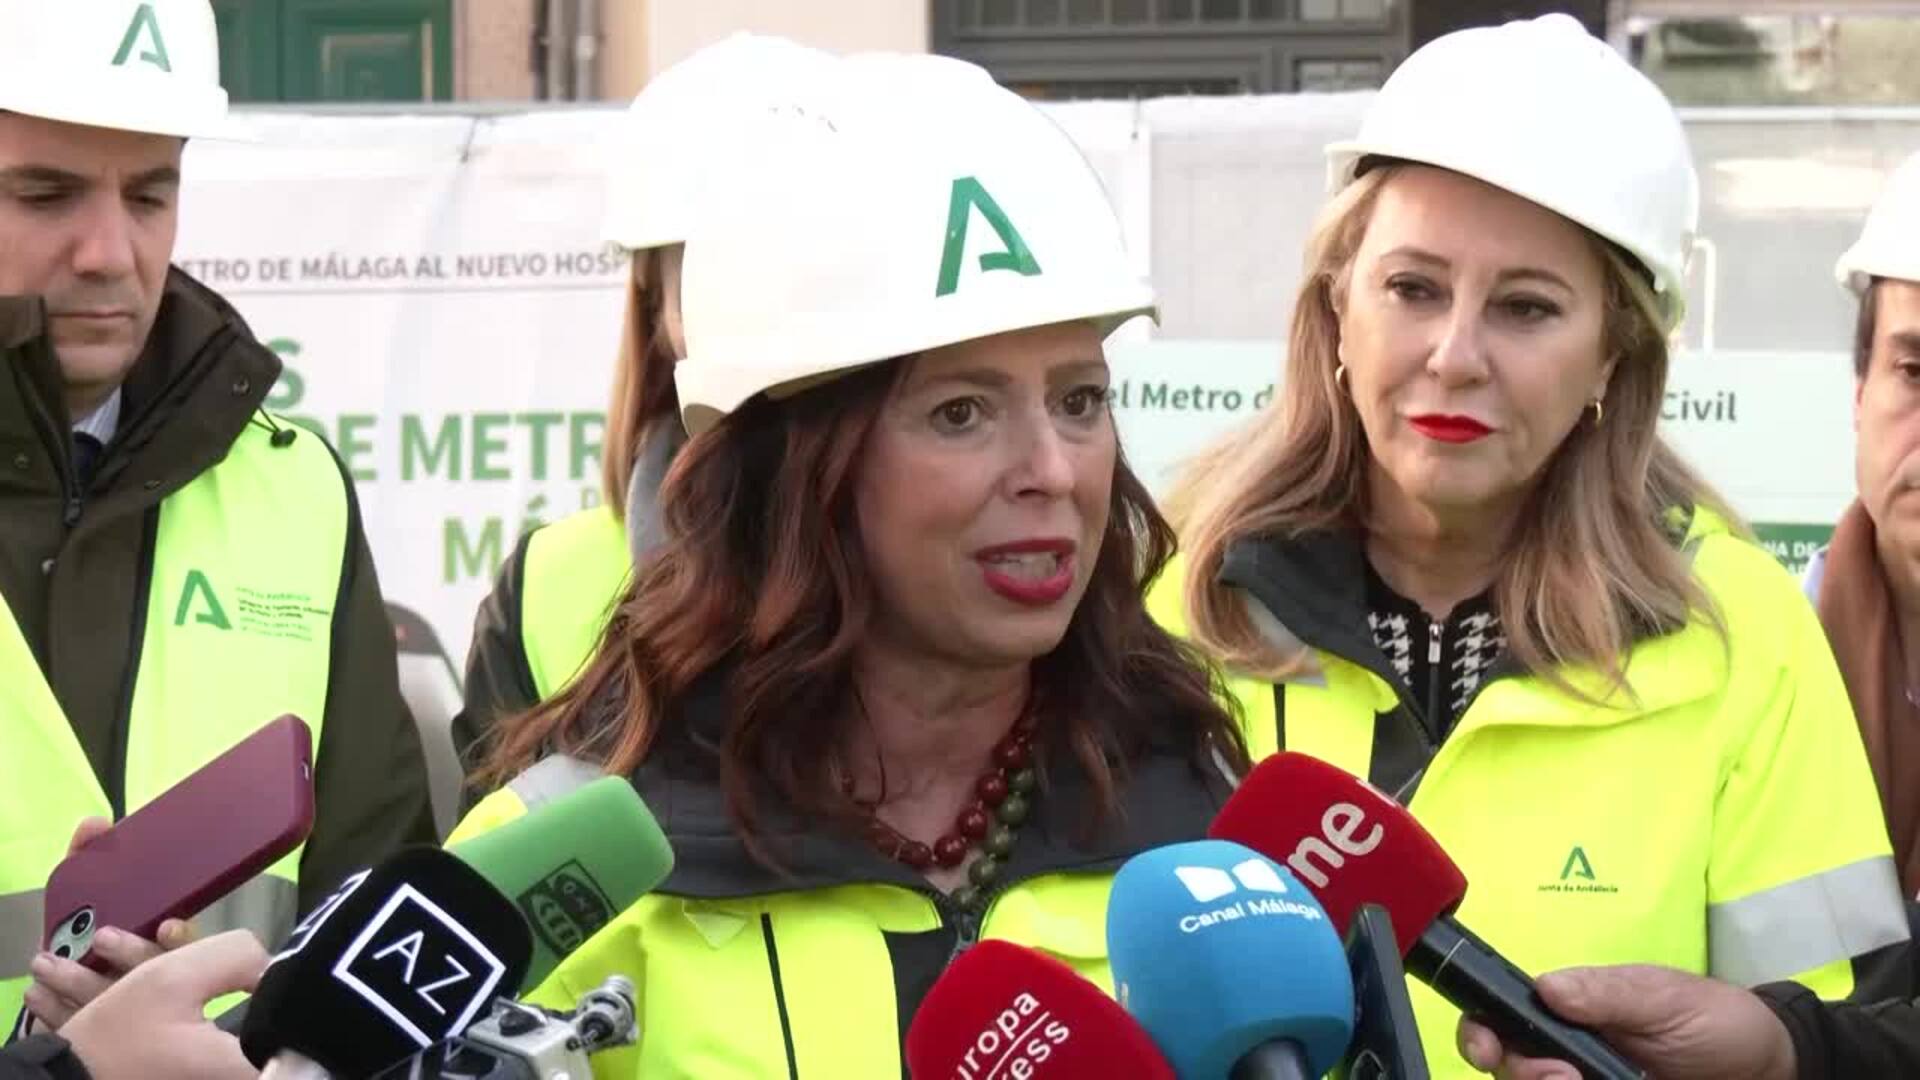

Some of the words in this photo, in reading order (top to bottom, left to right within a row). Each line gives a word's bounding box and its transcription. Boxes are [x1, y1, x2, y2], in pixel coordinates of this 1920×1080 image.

[258, 258, 289, 280] DE
[301, 250, 406, 280] MÁLAGA
[415, 255, 446, 278] AL
[456, 252, 547, 277] NUEVO
[1140, 382, 1242, 411] Metro
[1662, 390, 1736, 422] Civil
[401, 411, 607, 481] METR
[1180, 902, 1246, 933] Canal
[373, 930, 471, 1015] AZ
